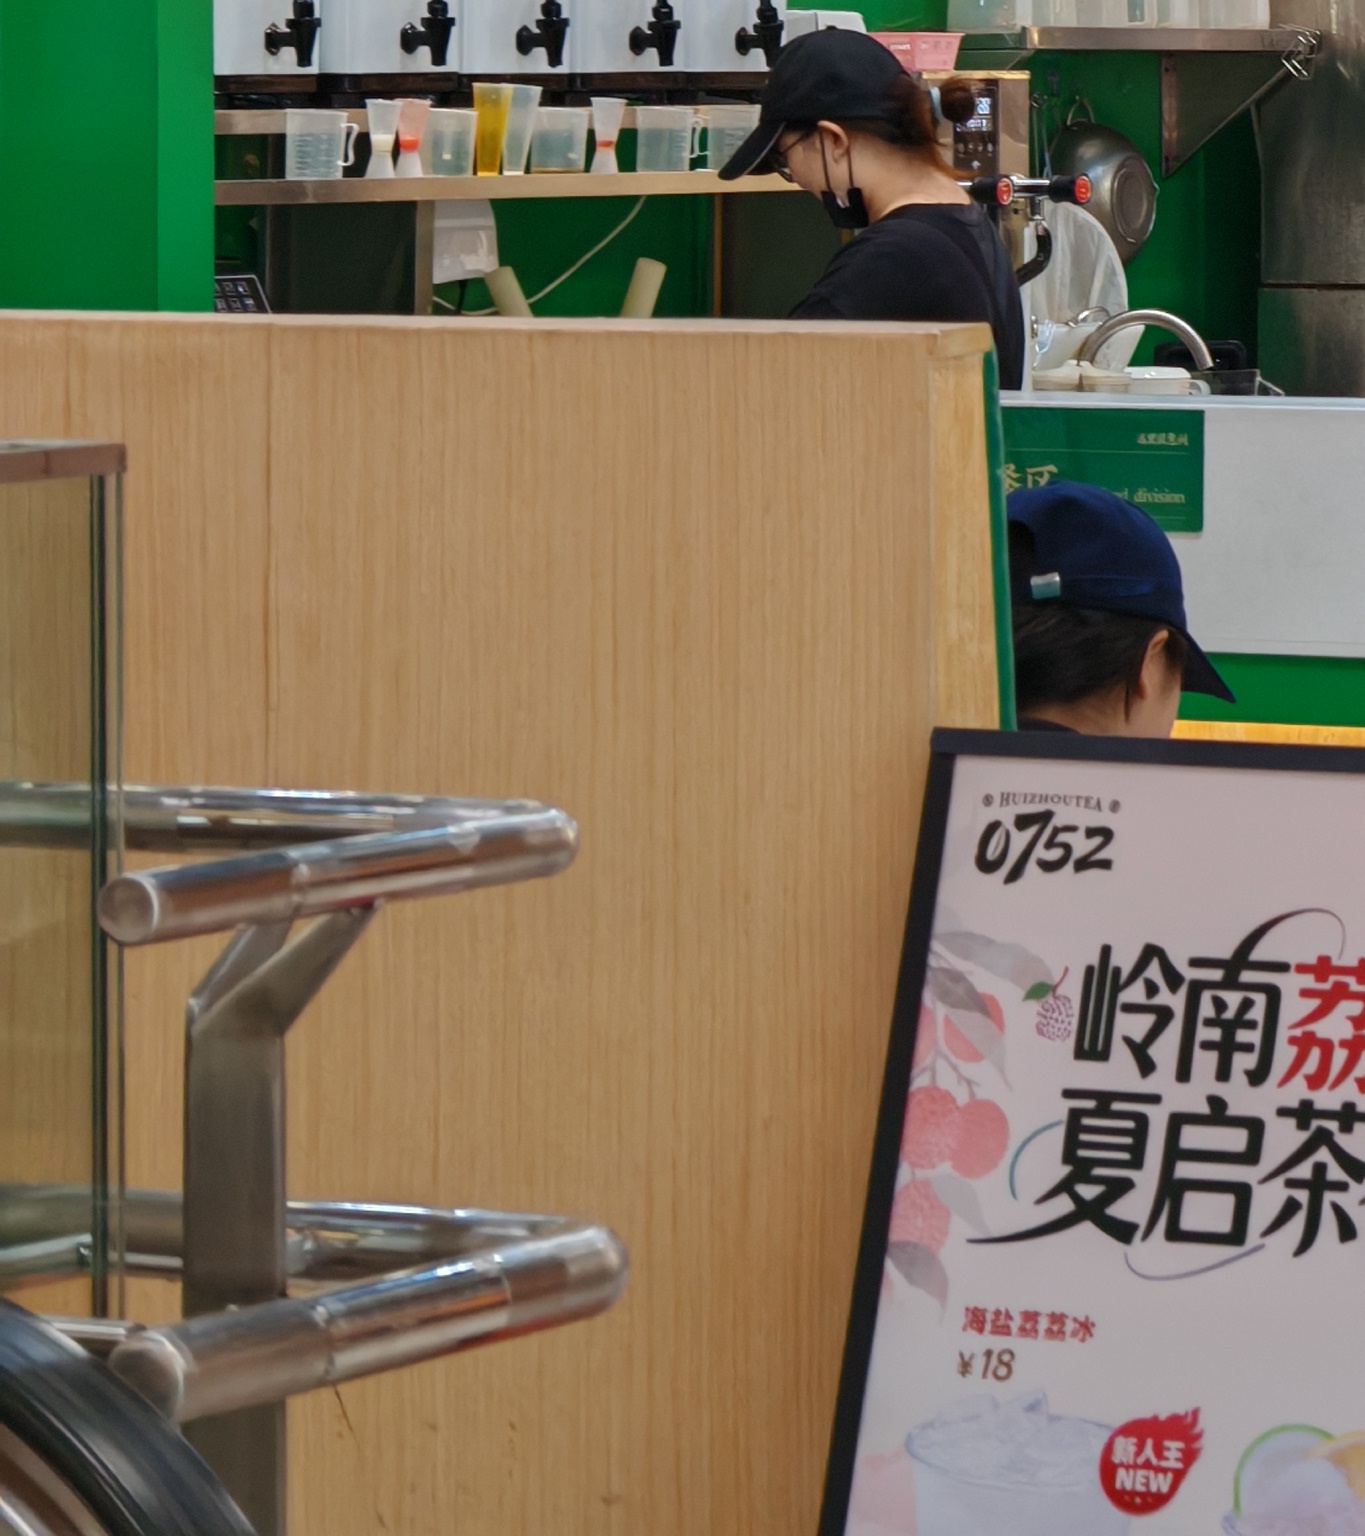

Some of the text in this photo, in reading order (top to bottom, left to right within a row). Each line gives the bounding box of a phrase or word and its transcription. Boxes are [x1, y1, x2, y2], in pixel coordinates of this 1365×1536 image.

[999, 791, 1103, 812] HUIZHOUTEA
[975, 808, 1115, 886] 0752
[957, 1348, 1016, 1382] ¥18
[1111, 1435, 1186, 1469] 新人王
[1115, 1467, 1174, 1494] NEW
